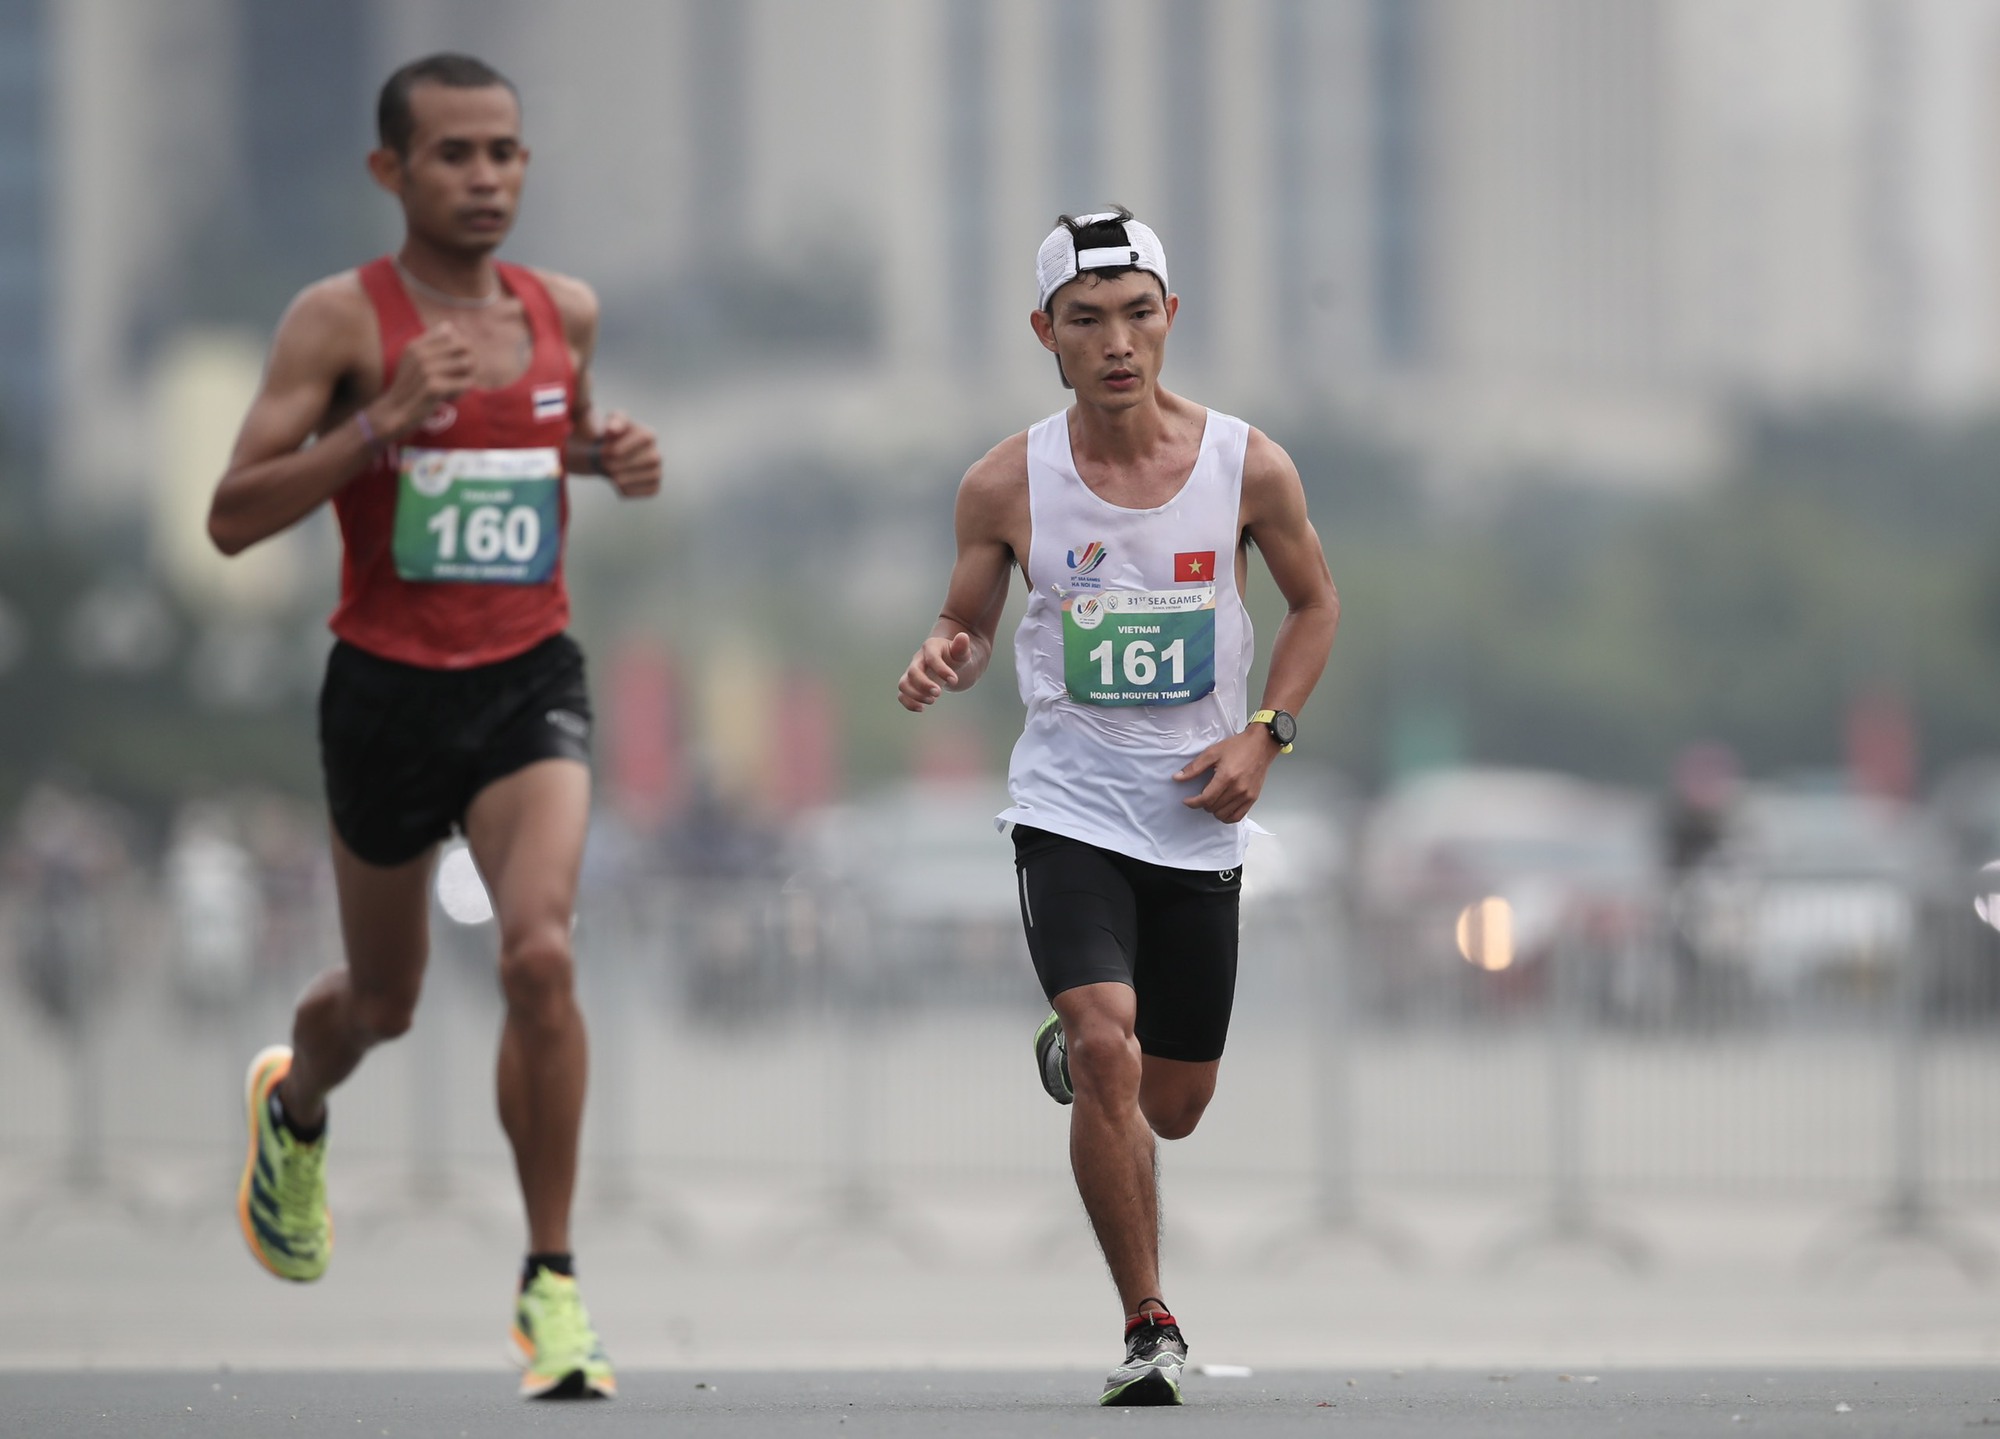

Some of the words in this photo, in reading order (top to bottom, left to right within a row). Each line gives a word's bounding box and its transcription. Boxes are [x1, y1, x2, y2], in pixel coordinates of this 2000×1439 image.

[428, 505, 541, 562] 160
[1148, 597, 1167, 605] SEA
[1169, 594, 1202, 605] GAMES
[1117, 625, 1160, 634] VIETNAM
[1089, 638, 1185, 685] 161
[1090, 691, 1120, 700] HOANG
[1122, 691, 1159, 700] NGUYEN
[1160, 690, 1190, 699] THANH
